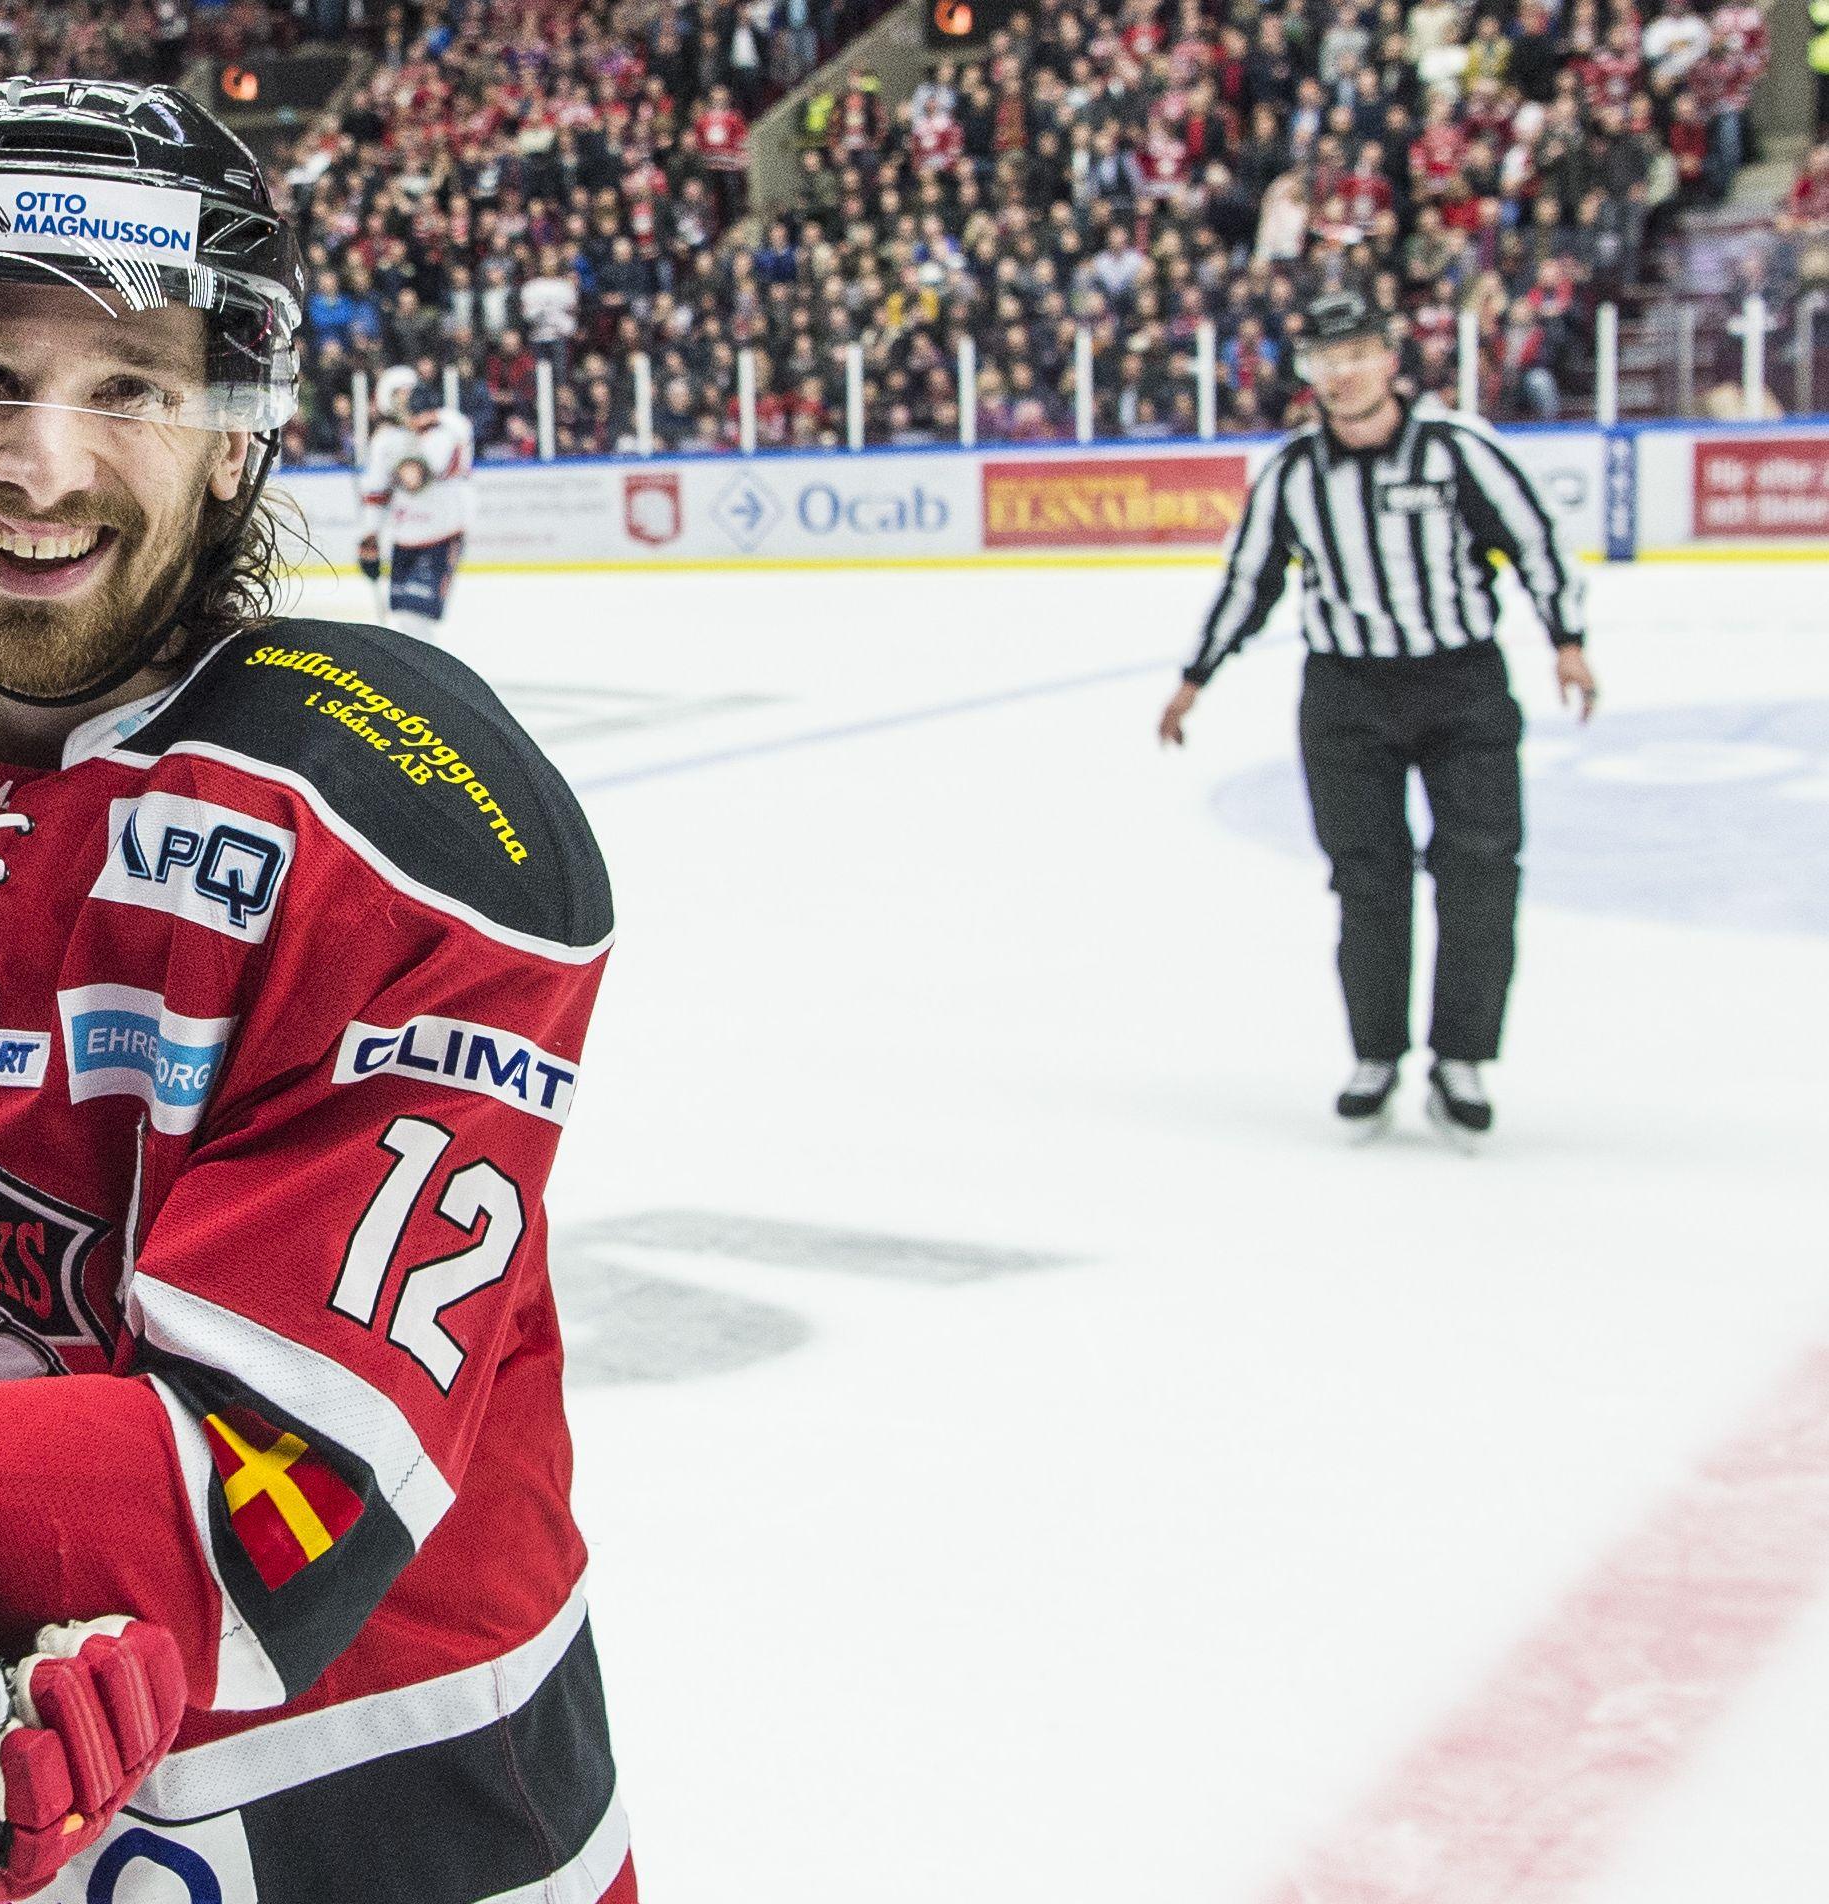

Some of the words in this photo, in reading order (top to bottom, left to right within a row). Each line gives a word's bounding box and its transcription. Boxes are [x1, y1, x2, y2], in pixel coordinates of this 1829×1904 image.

[13, 213, 191, 251] MAGNUSSON
[15, 190, 87, 214] OTTO
[796, 480, 950, 534] Ocab
[245, 646, 528, 866] Ställningsbyggarna
[304, 692, 317, 707] i
[318, 699, 392, 752] Skåne
[389, 750, 438, 787] AB
[326, 1113, 528, 1399] 12
